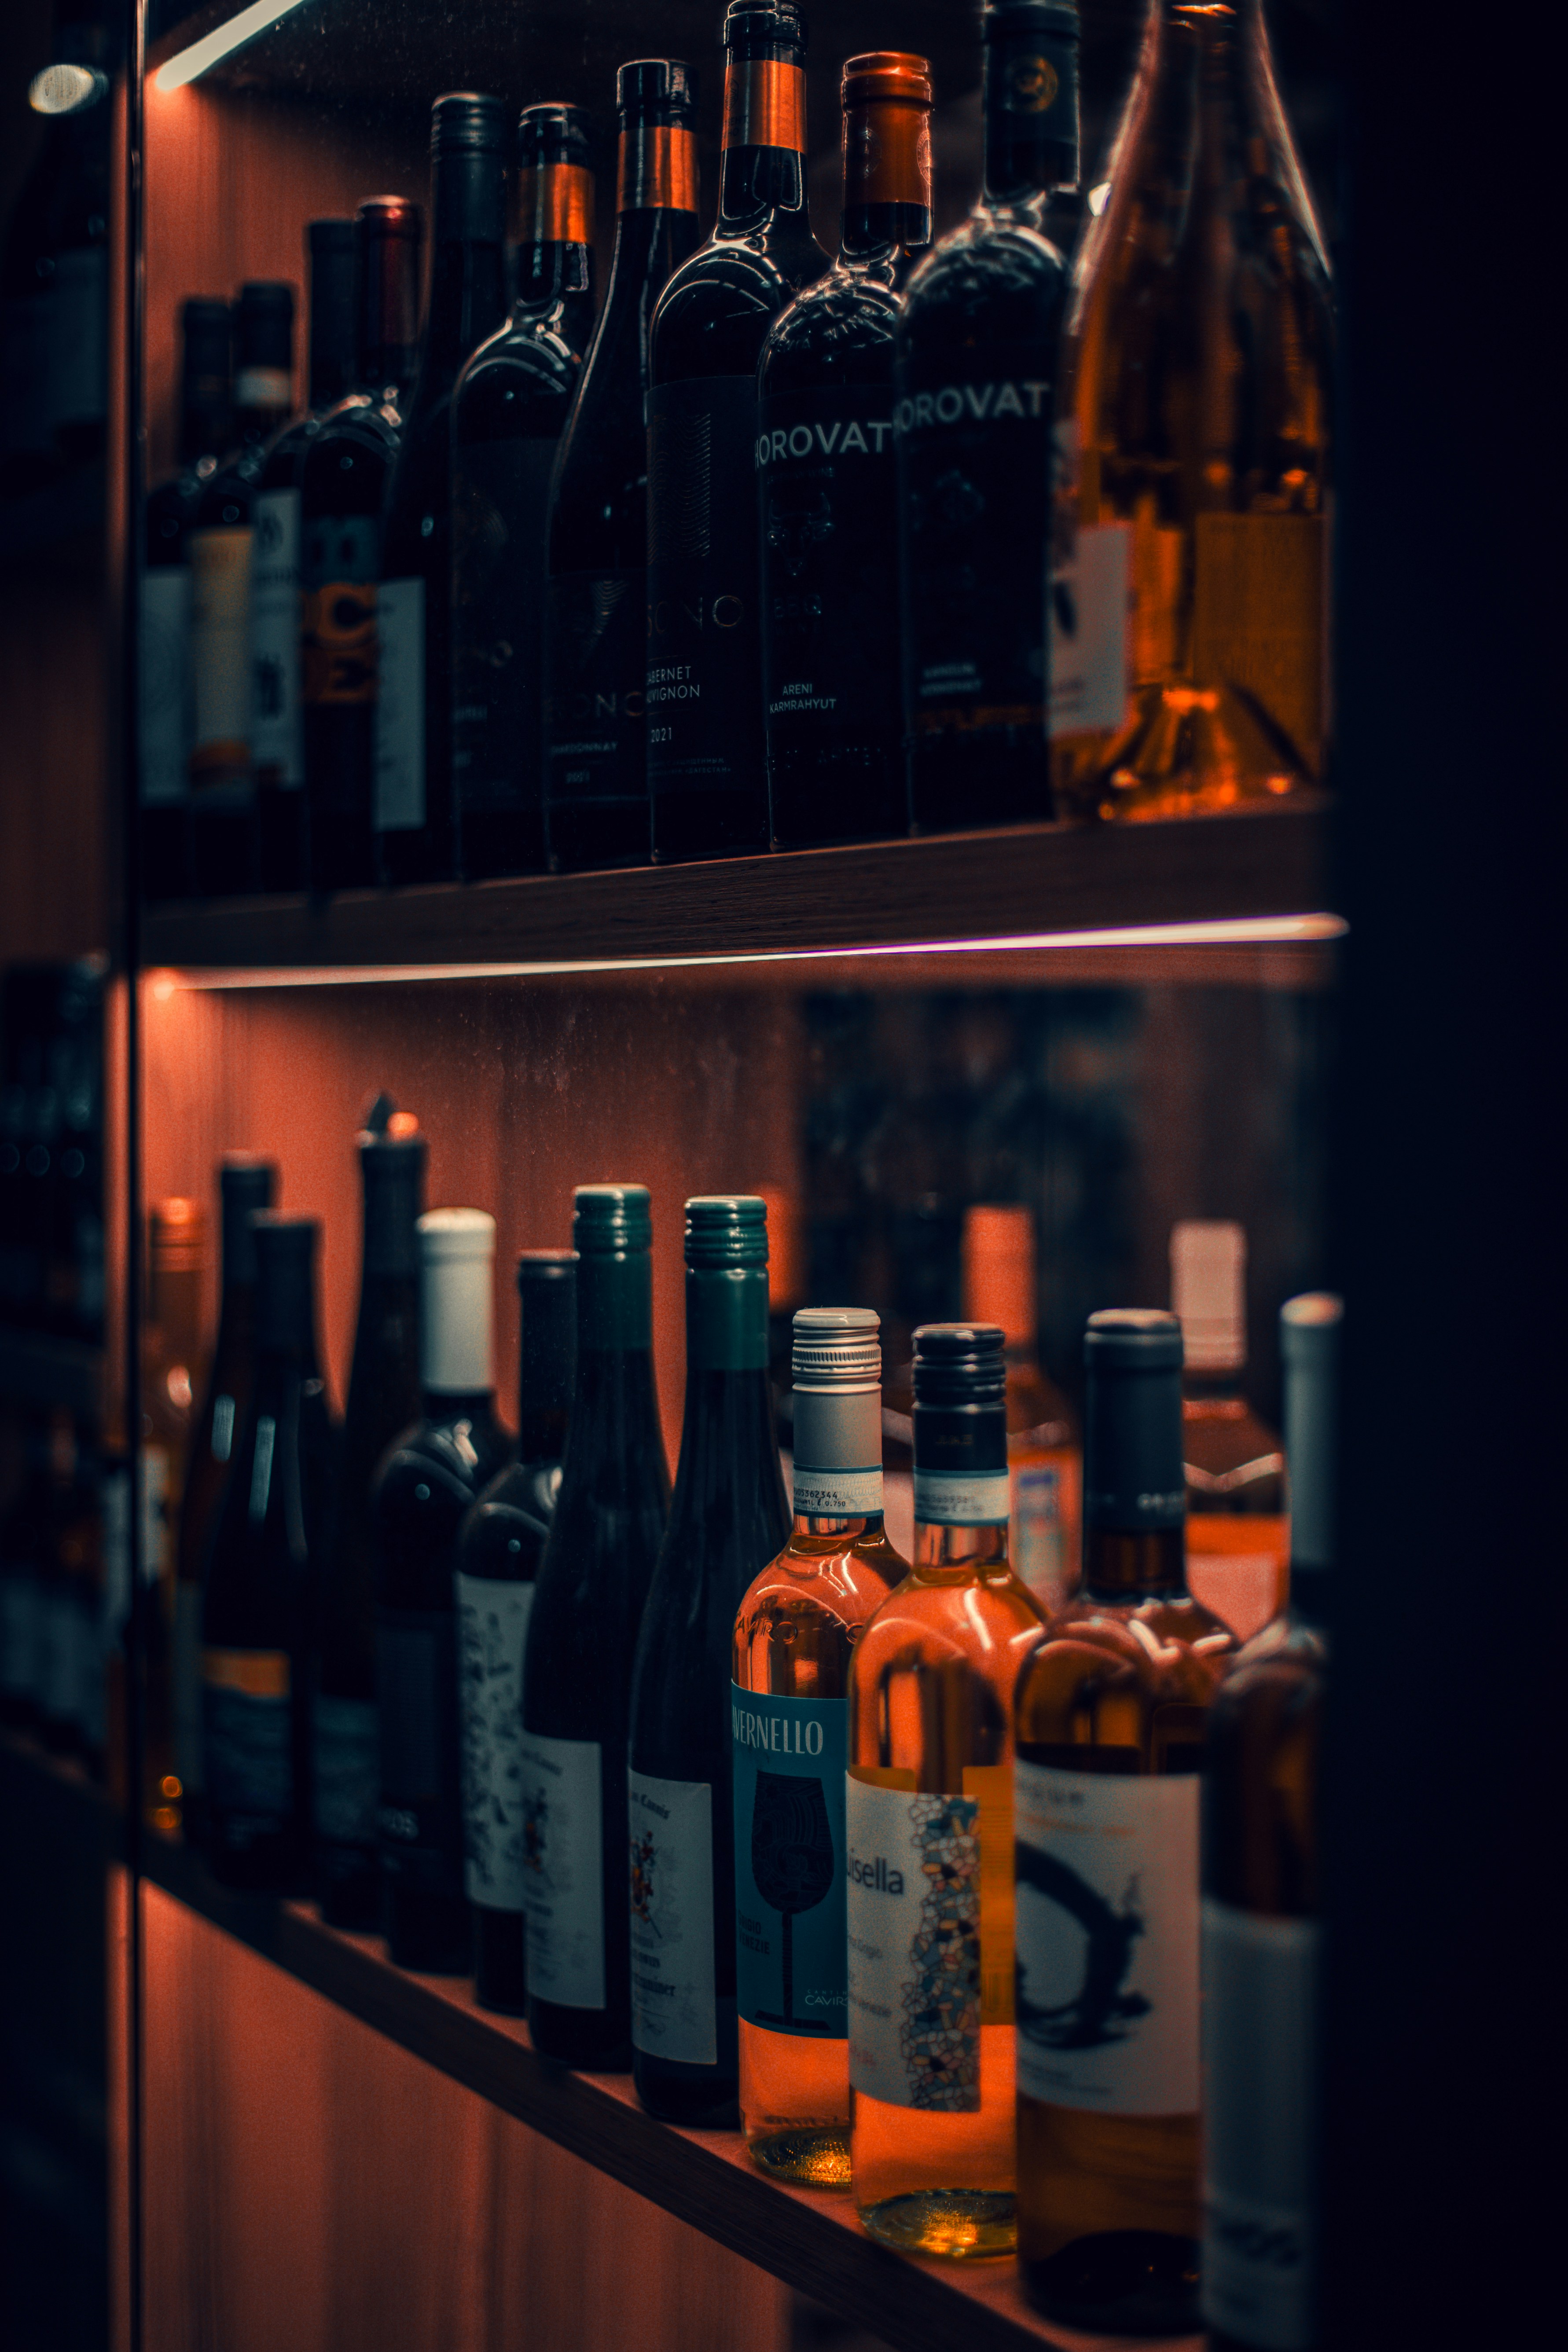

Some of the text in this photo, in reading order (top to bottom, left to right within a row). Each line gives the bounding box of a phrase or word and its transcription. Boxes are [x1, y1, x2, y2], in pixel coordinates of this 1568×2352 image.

[782, 683, 813, 696] ARENI
[770, 698, 837, 715] KARMRAHYUT
[650, 727, 672, 744] 2021
